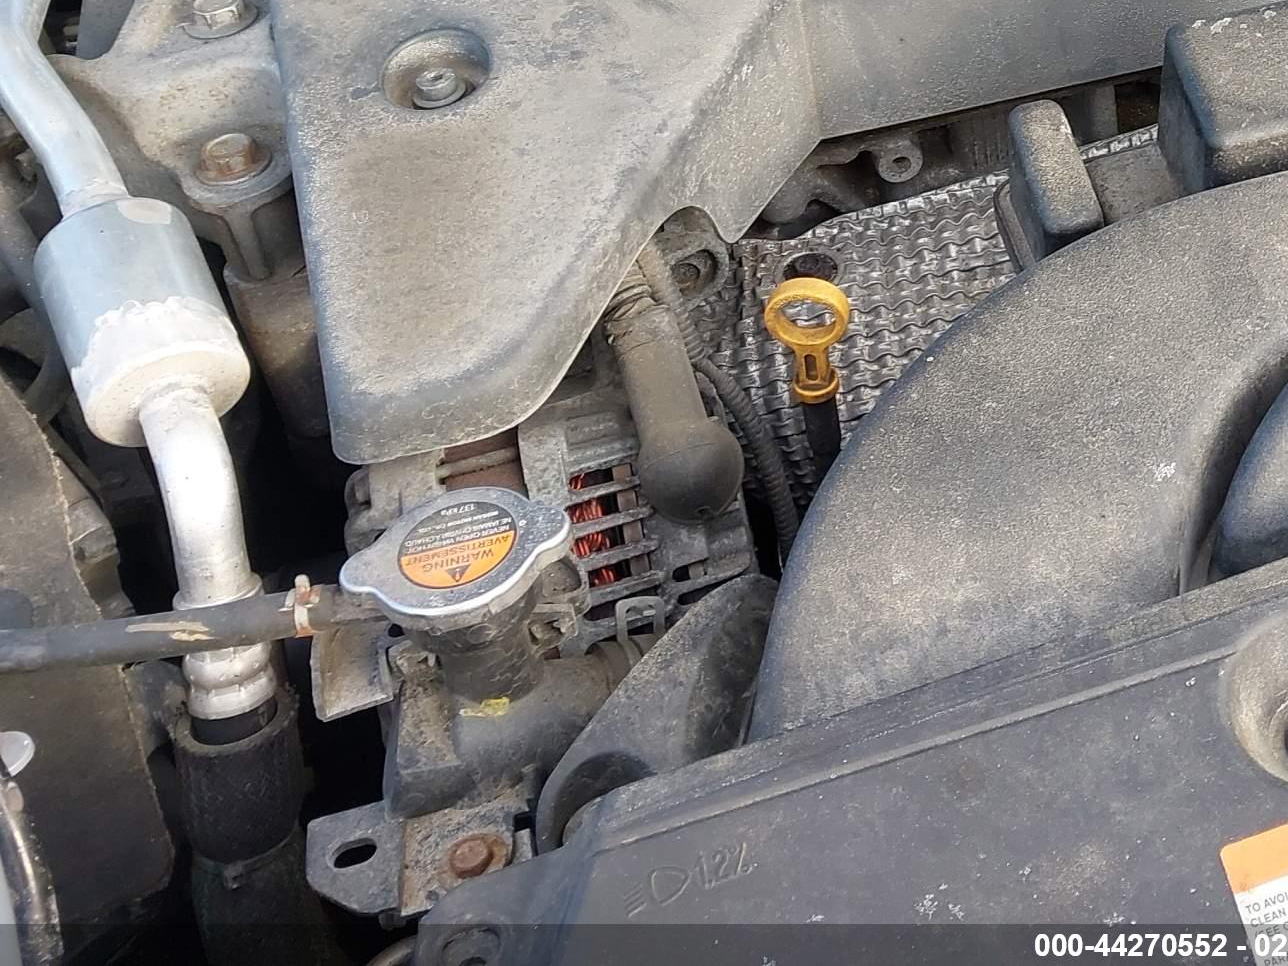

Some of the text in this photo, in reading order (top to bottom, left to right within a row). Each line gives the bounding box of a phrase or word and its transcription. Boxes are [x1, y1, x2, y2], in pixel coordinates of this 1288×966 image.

[456, 530, 480, 543] OPEN
[482, 525, 510, 536] NEVER
[405, 534, 510, 566] AVERTISSEMENT
[422, 548, 494, 572] WARNING
[1245, 902, 1261, 914] TO
[1250, 907, 1286, 927] CLEAN
